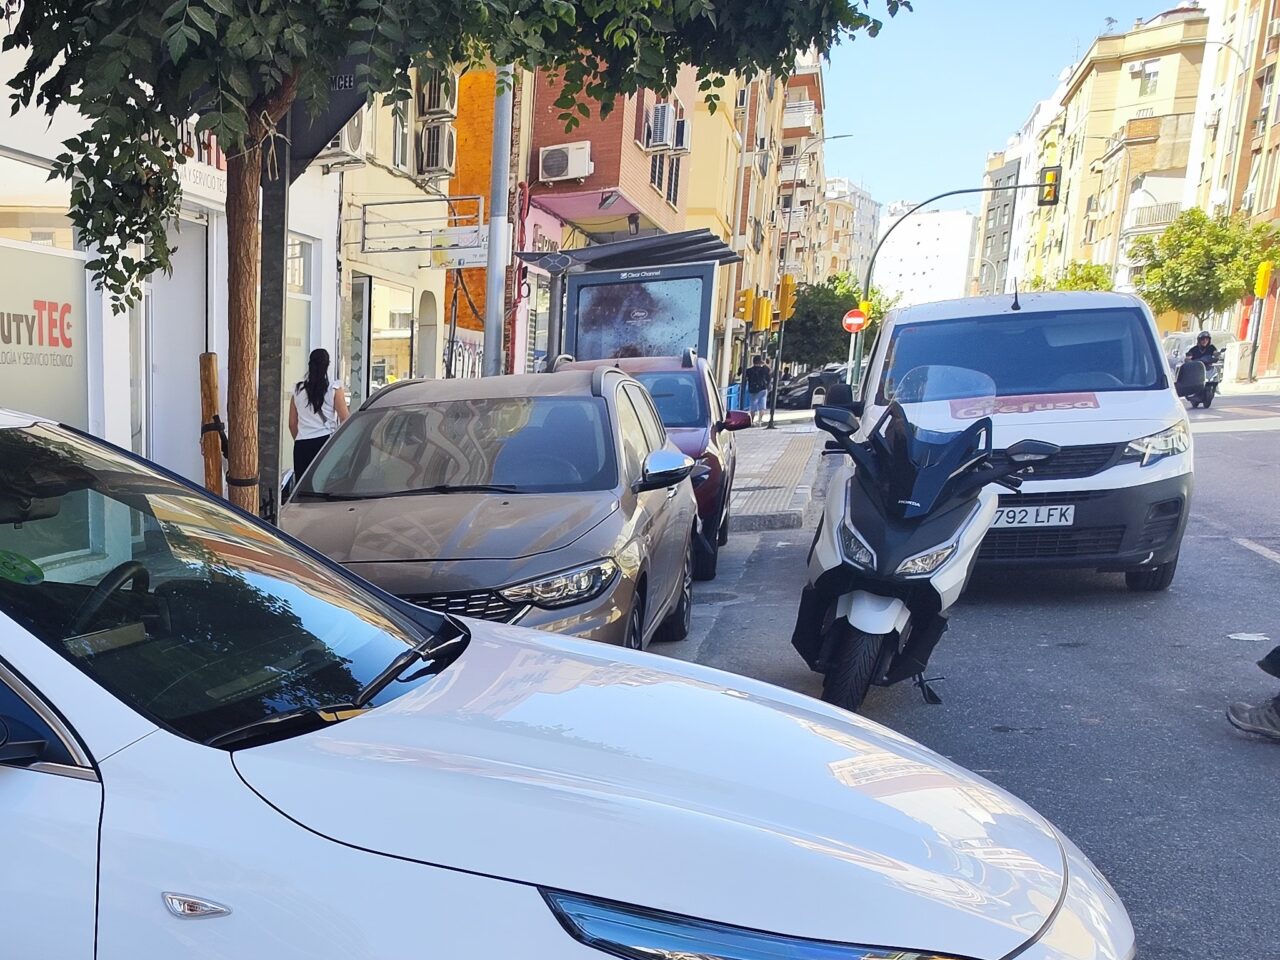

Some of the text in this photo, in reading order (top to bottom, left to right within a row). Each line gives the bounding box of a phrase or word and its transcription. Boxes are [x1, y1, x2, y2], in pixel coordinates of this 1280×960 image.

[23, 351, 48, 366] SERVICIO
[956, 401, 1096, 418] Grefusa
[994, 507, 1070, 525] 792 LFK
